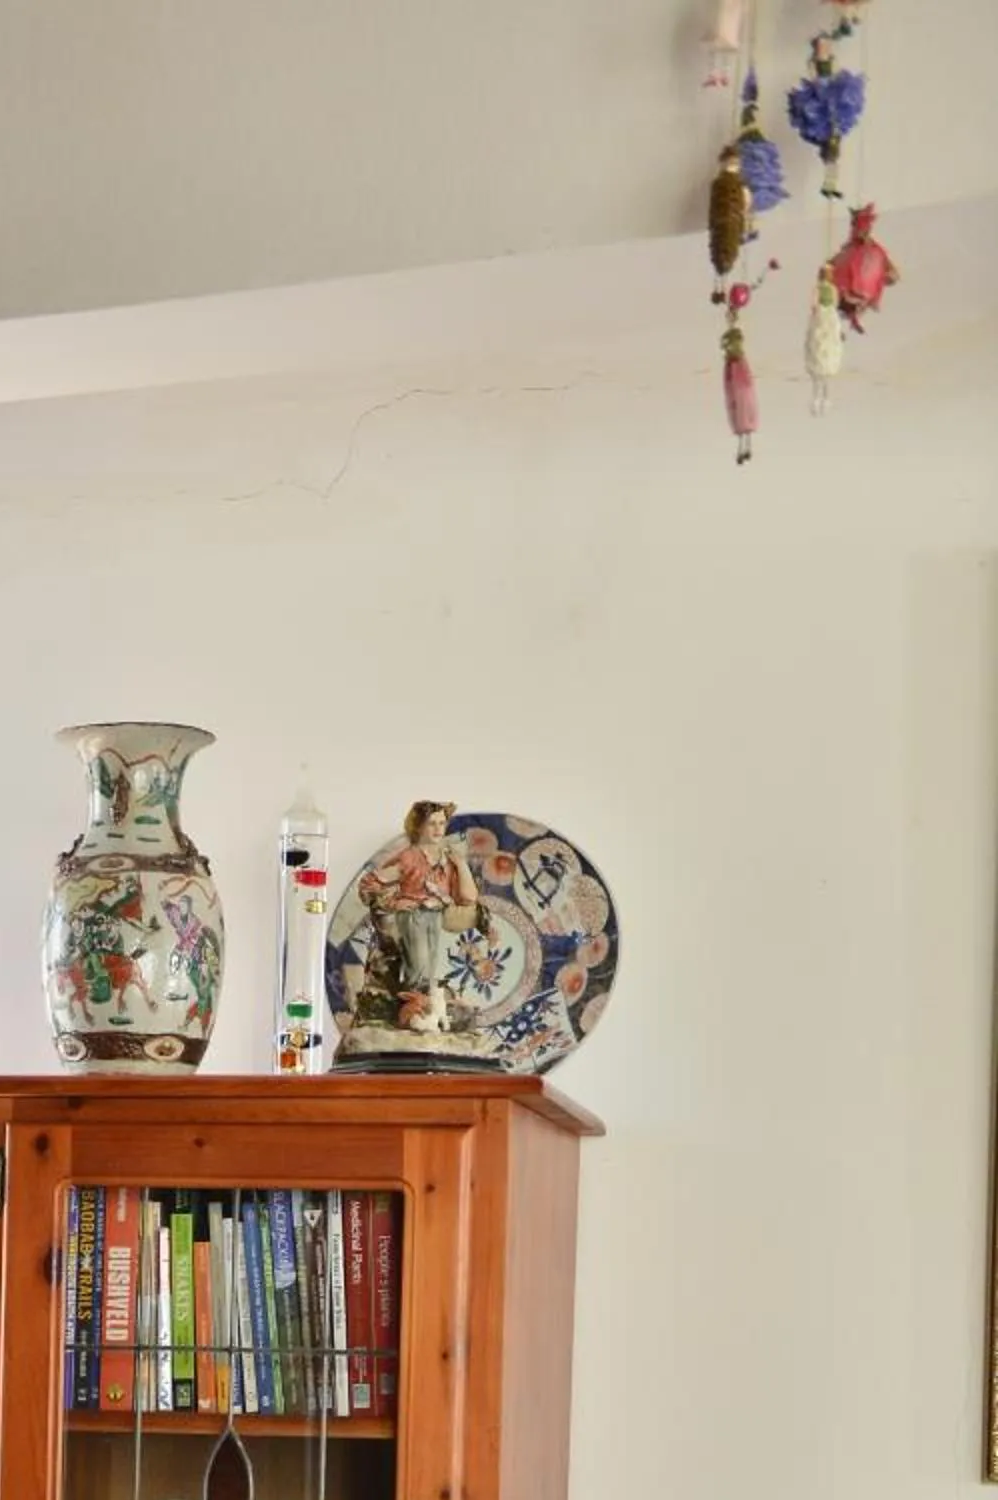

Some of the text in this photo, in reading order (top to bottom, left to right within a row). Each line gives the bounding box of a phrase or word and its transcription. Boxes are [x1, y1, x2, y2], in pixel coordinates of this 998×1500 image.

[351, 1201, 363, 1250] Medicinal
[78, 1268, 93, 1320] TRAILS
[105, 1246, 132, 1341] BUSHVELD
